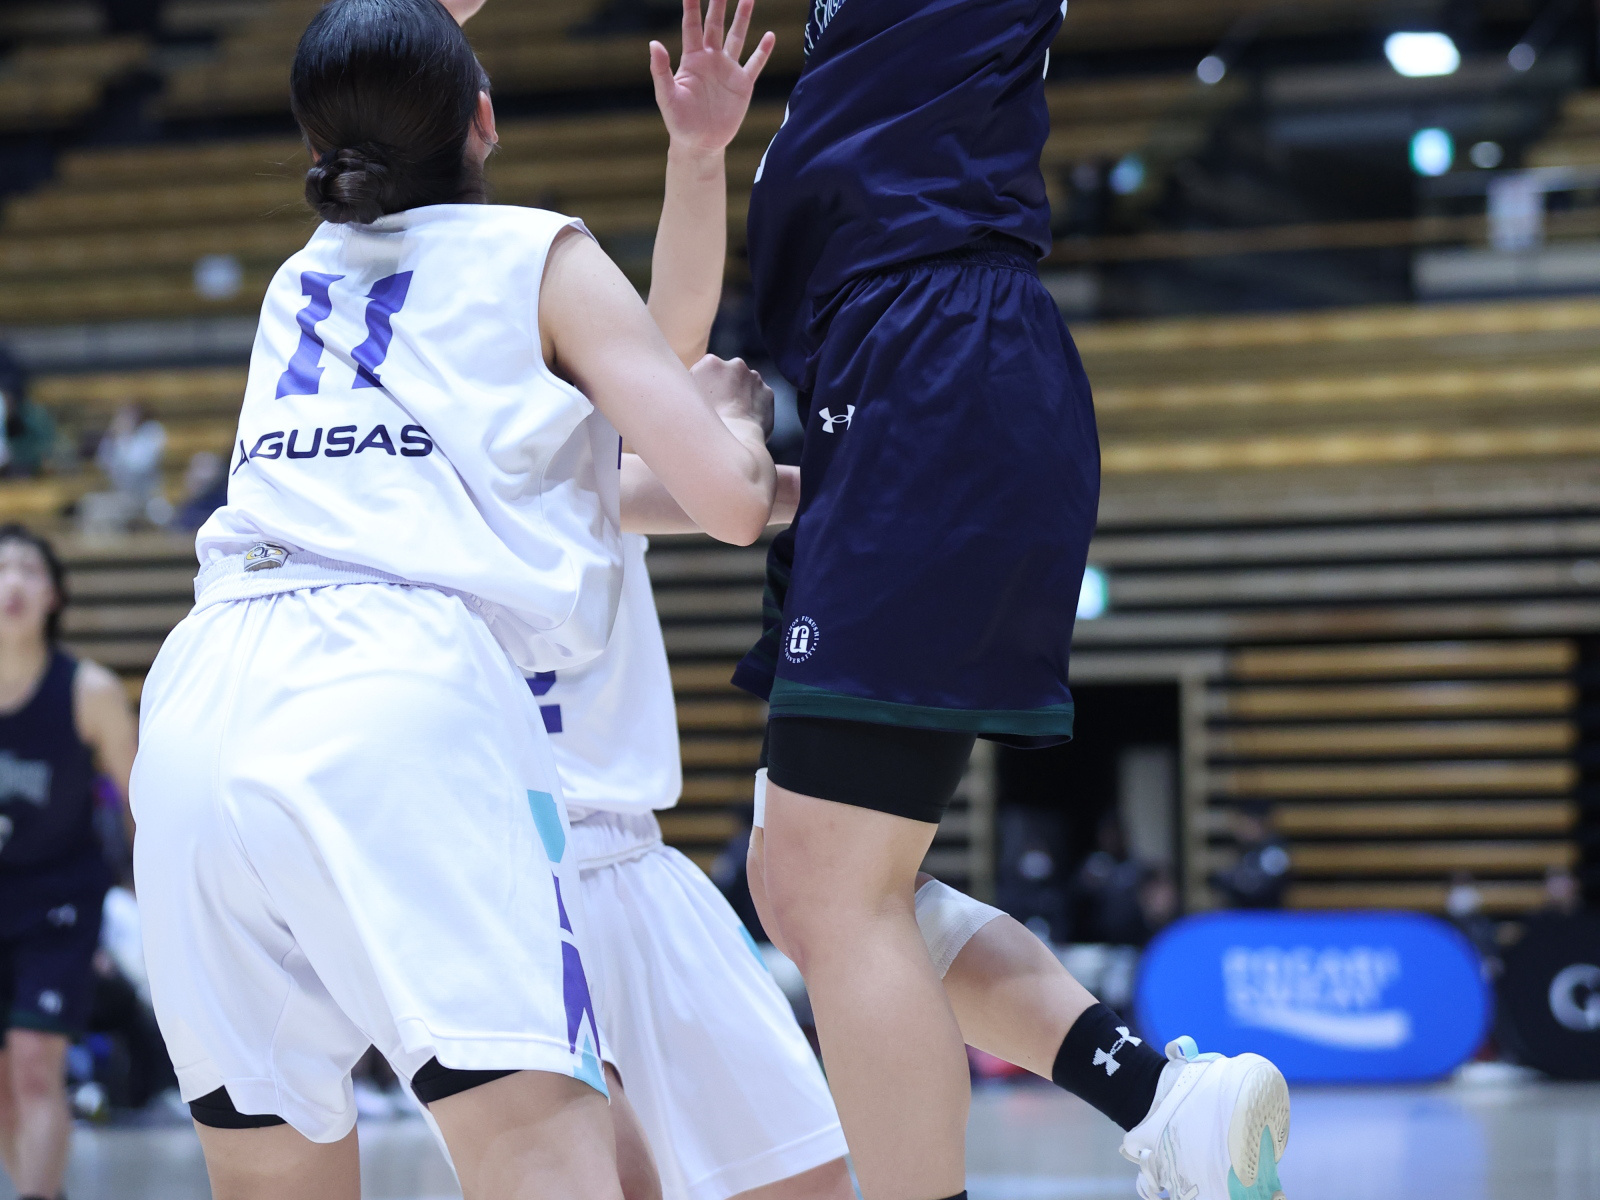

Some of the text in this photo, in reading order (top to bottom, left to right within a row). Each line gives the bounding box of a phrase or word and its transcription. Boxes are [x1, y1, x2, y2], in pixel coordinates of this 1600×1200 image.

[275, 270, 414, 400] 11
[801, 615, 820, 641] FUKUSHI
[784, 646, 816, 664] UNIVERSITY
